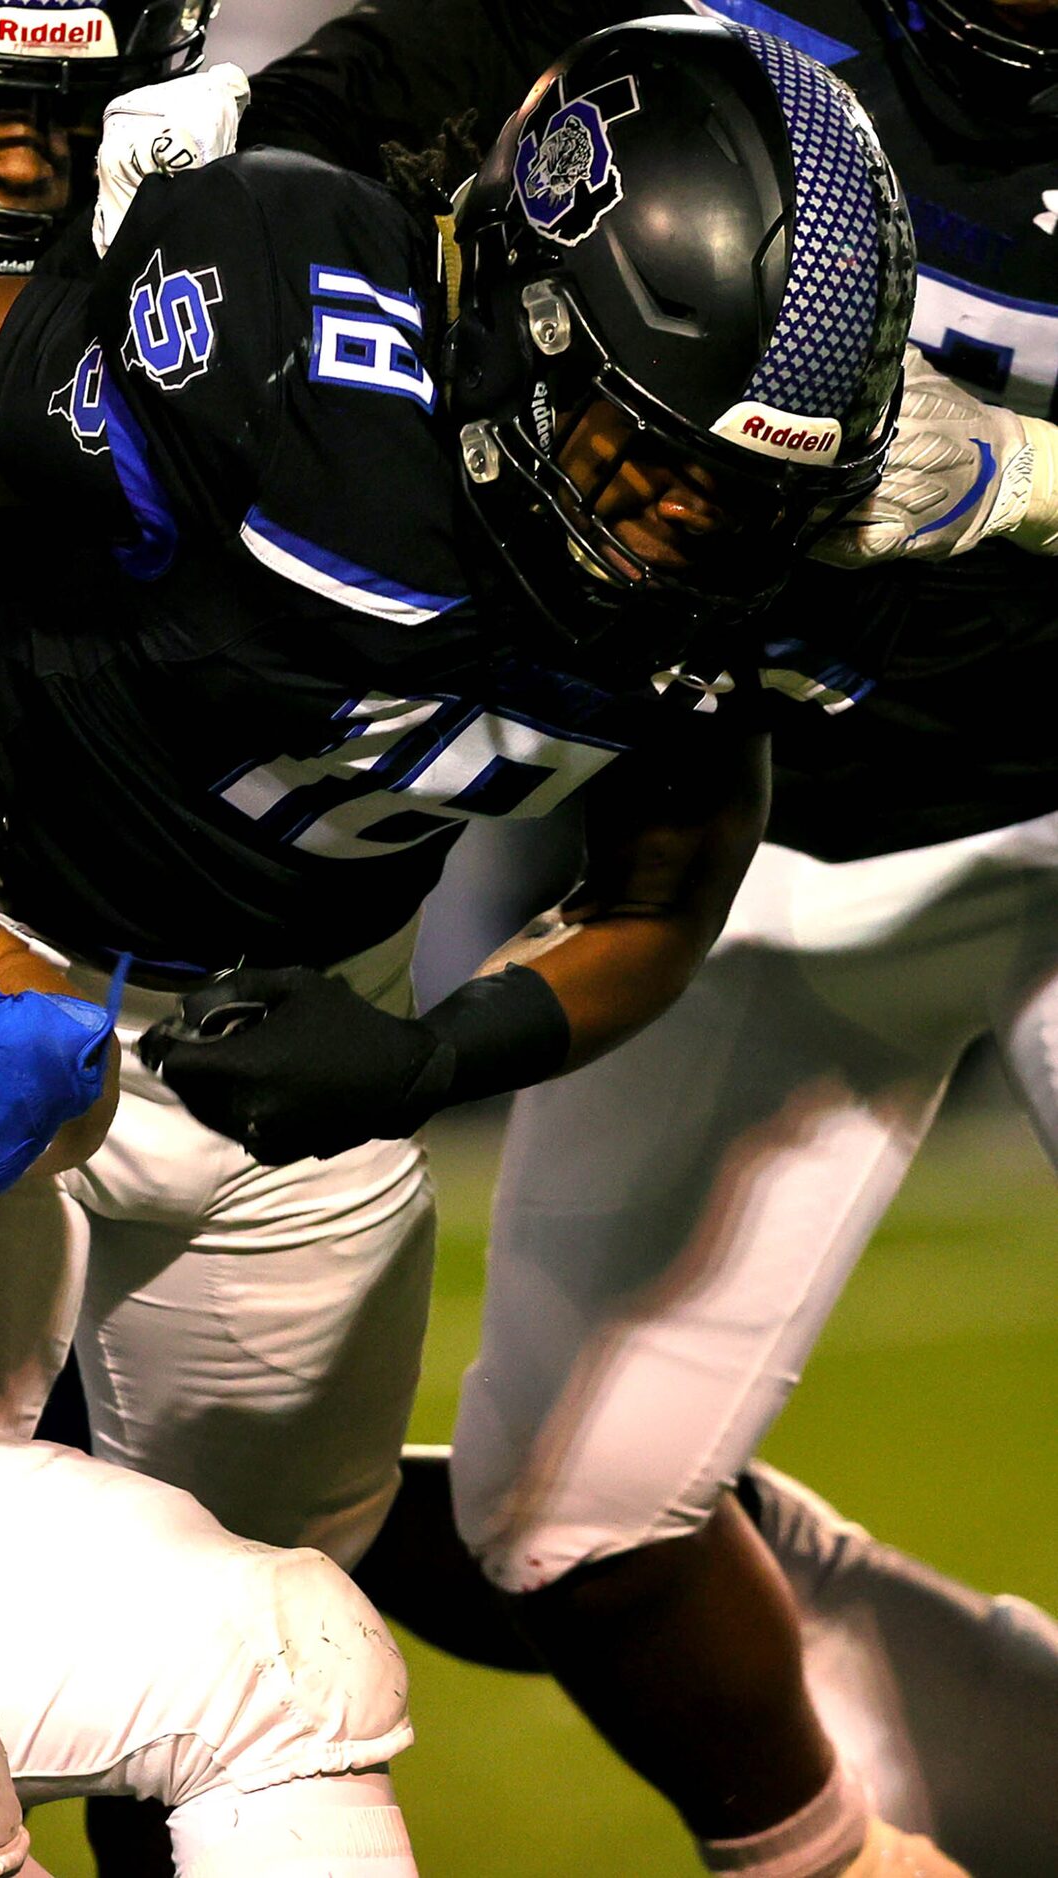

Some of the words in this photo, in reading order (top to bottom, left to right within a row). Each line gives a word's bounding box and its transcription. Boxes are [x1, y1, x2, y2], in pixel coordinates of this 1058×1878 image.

[129, 269, 214, 376] S
[308, 262, 440, 416] 18
[741, 415, 836, 452] Riddell
